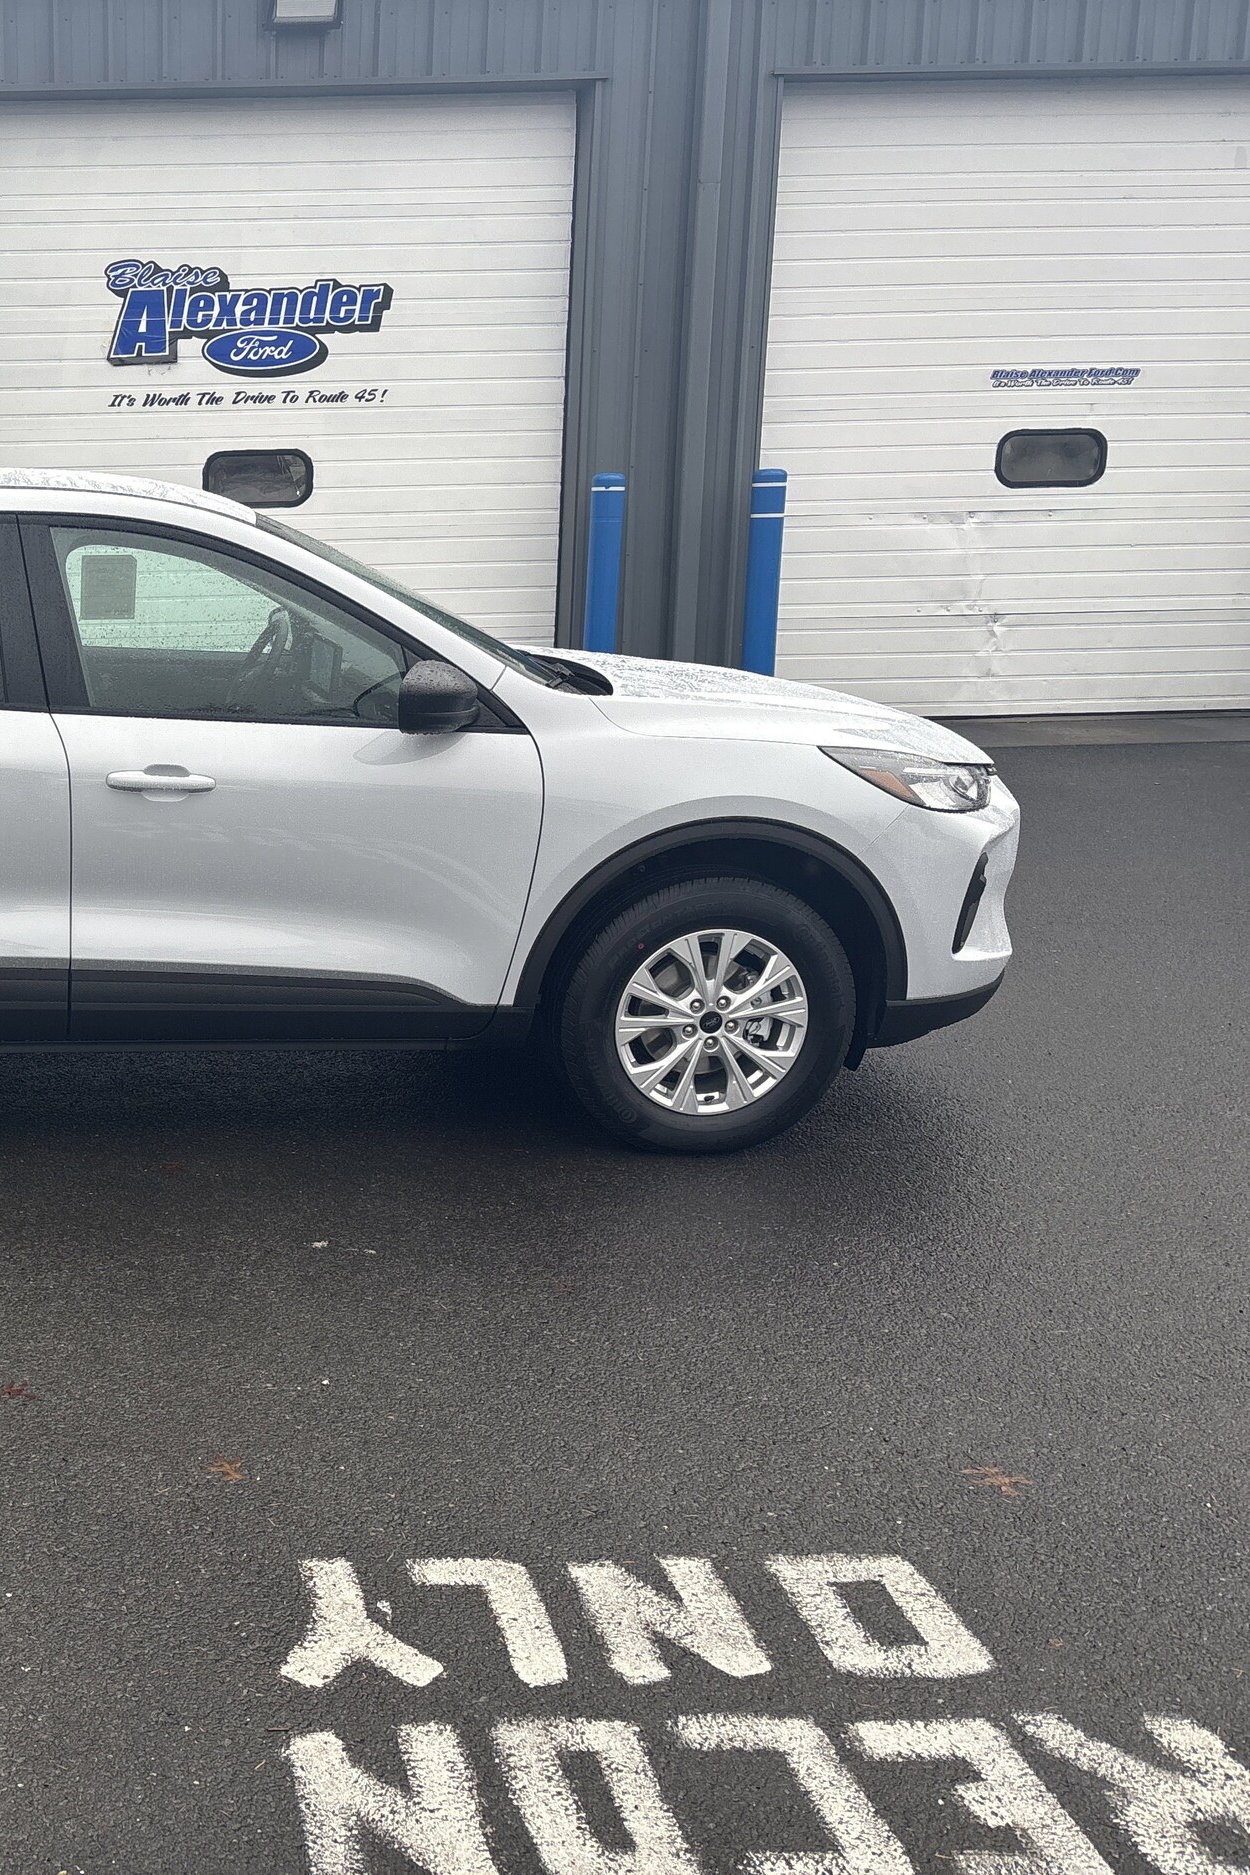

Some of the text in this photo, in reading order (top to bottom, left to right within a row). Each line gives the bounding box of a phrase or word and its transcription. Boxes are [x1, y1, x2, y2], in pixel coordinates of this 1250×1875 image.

[106, 260, 223, 289] Blaise
[108, 279, 387, 360] Alexander
[229, 334, 293, 361] Ford
[107, 394, 137, 408] It's
[141, 392, 191, 407] Worth
[196, 391, 224, 406] The
[231, 390, 277, 405] Drive
[280, 390, 300, 404] To
[304, 389, 350, 404] Route
[279, 1554, 997, 1688] ONLY
